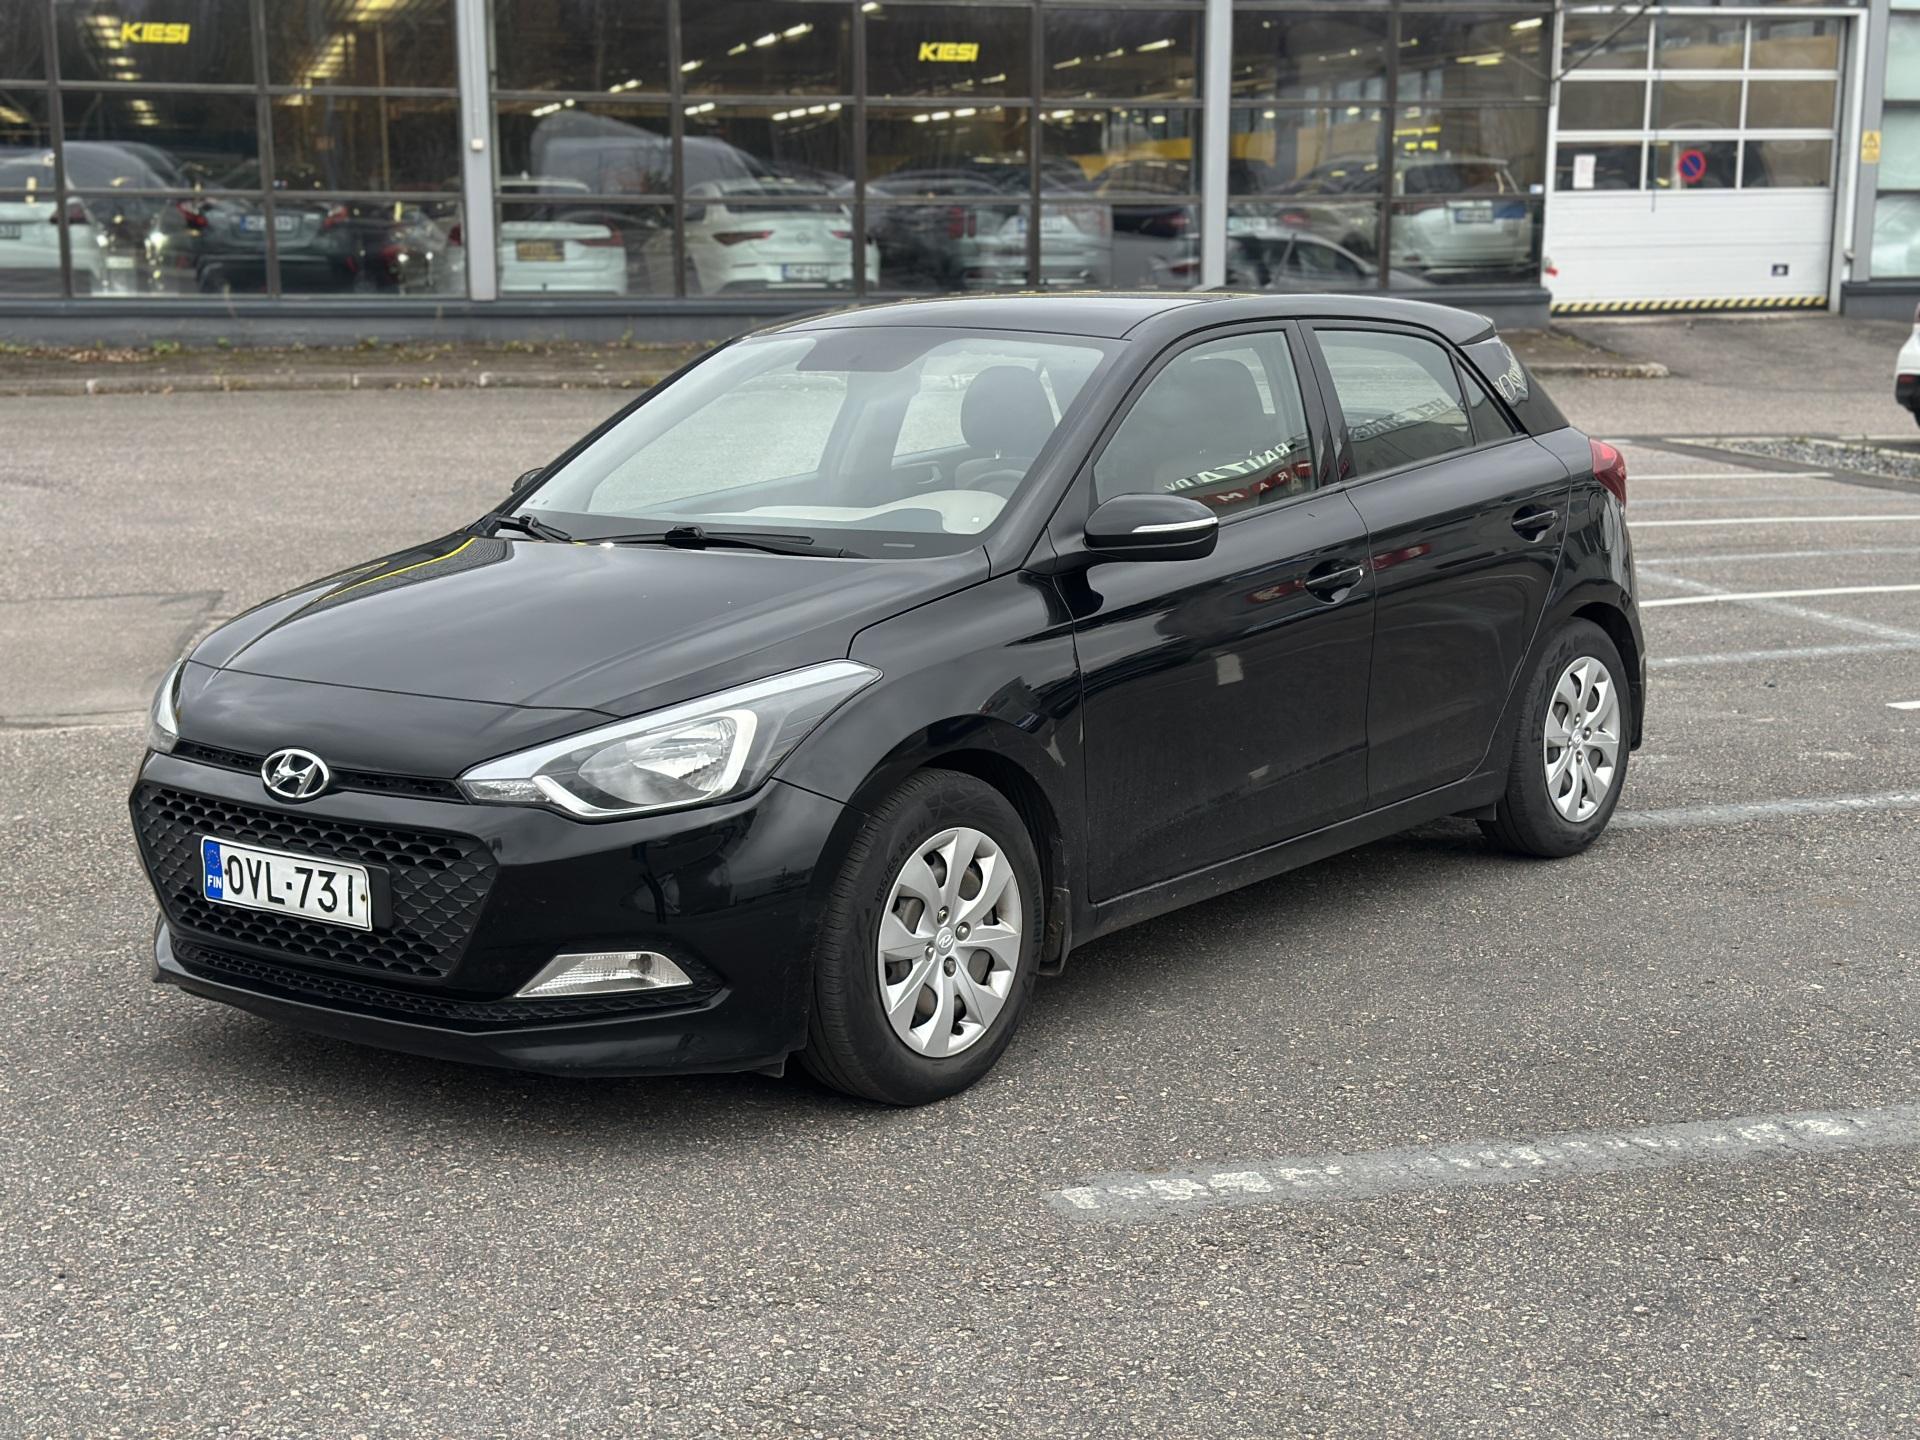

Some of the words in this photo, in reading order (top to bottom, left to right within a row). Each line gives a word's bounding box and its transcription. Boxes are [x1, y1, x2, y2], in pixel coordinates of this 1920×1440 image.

[121, 22, 190, 44] KIESI
[918, 42, 979, 62] KIESI
[207, 874, 223, 889] FIN
[227, 854, 354, 917] OVL-731
